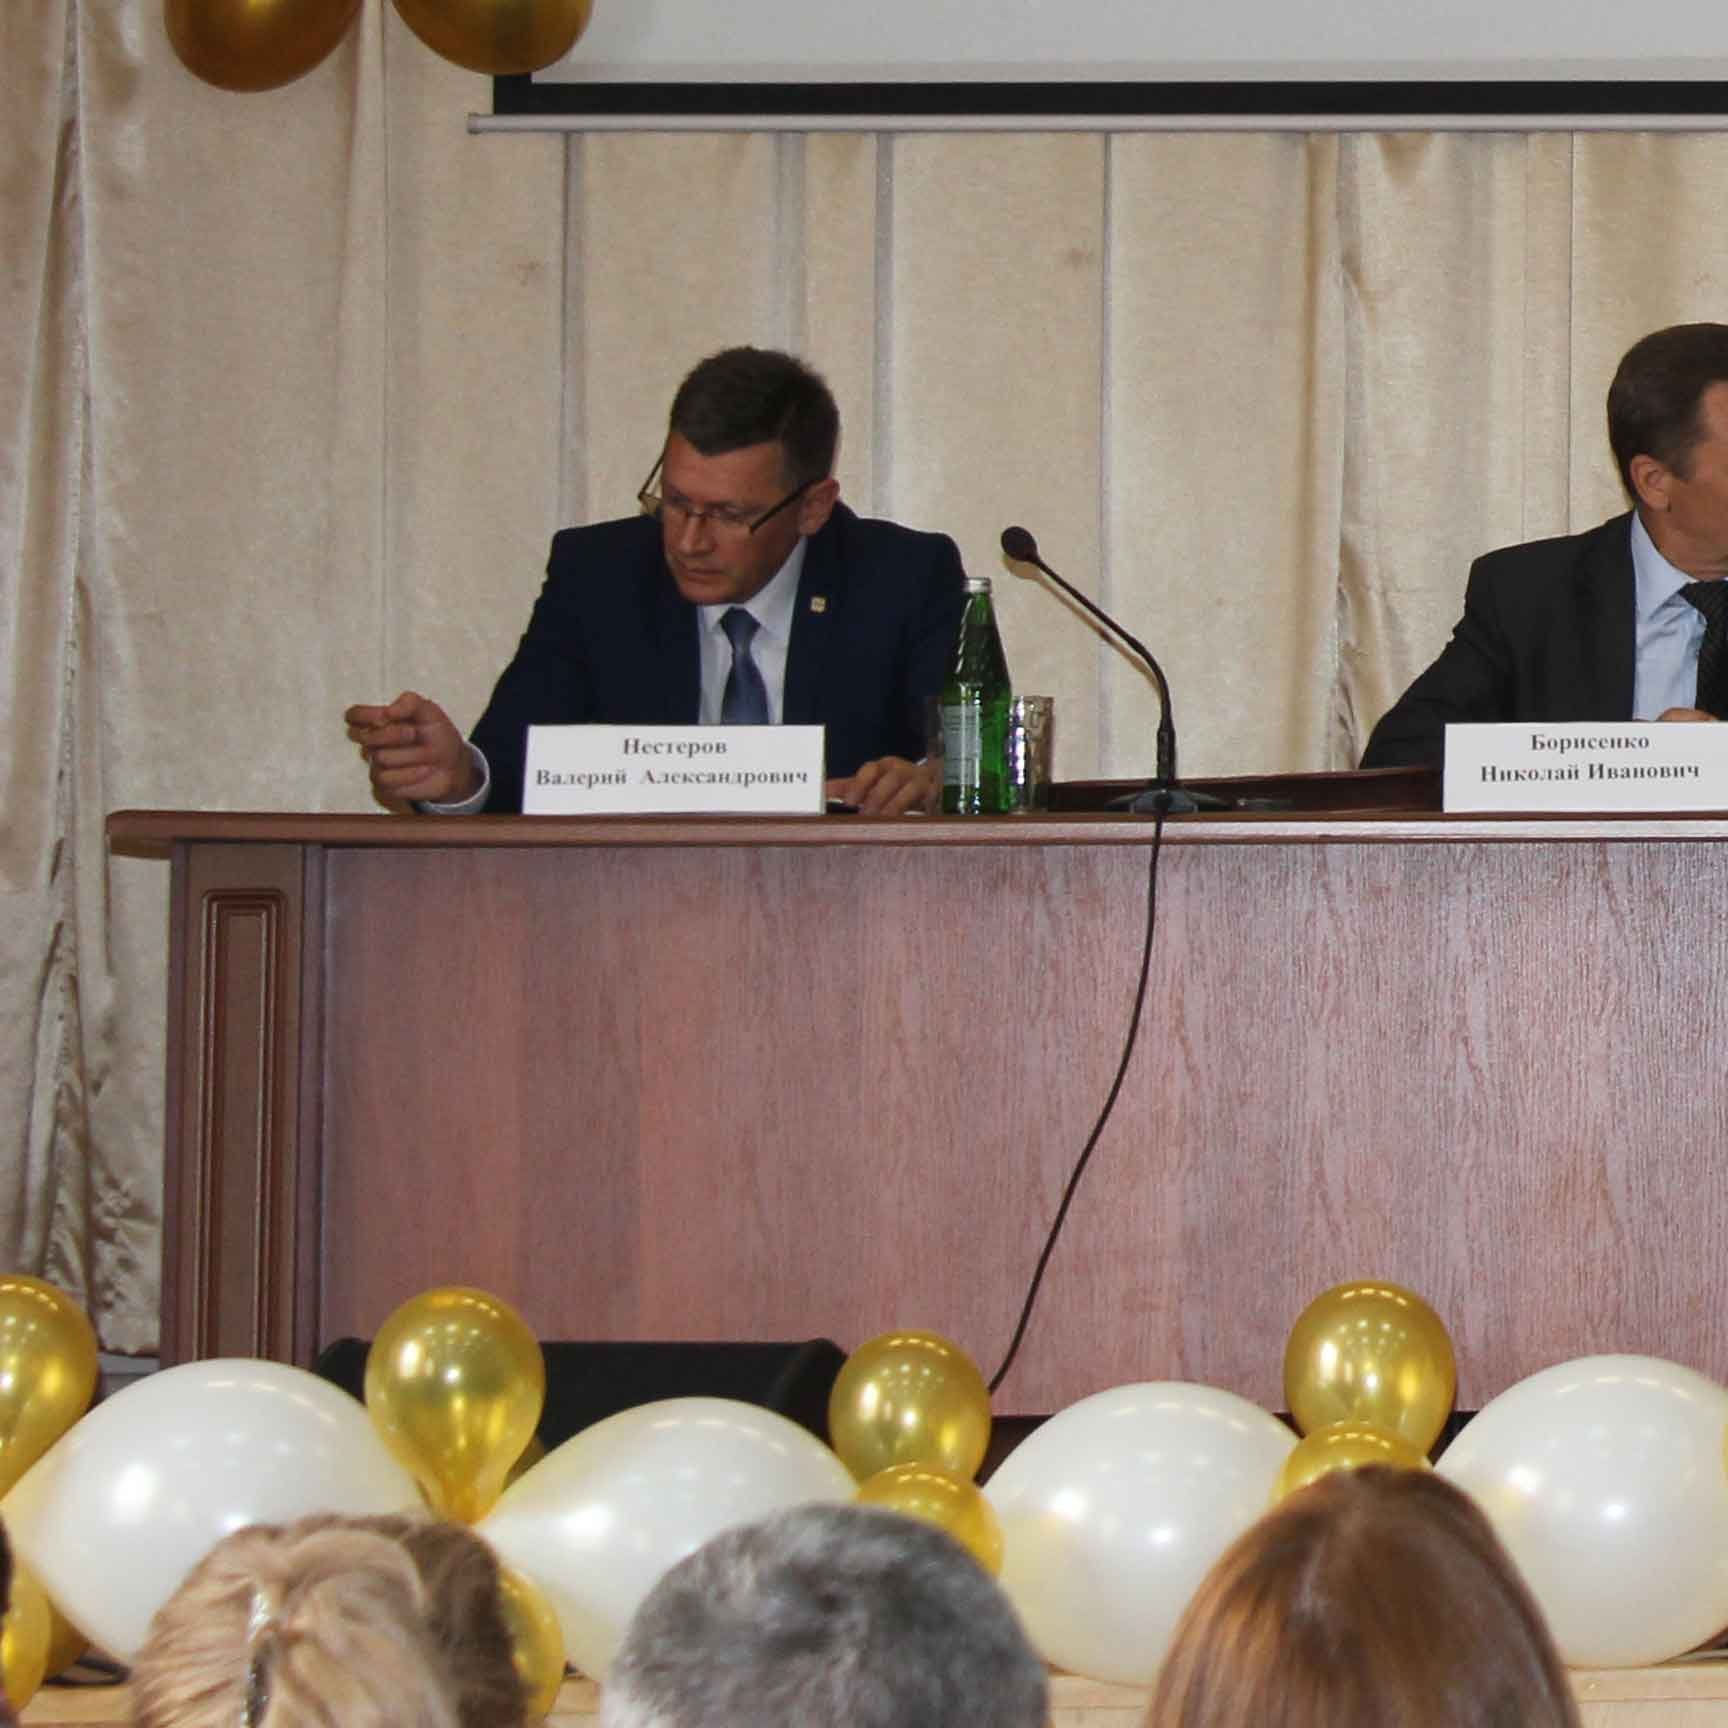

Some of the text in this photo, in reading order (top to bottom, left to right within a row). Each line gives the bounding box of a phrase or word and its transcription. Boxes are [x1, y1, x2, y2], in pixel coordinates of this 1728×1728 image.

[622, 737, 728, 759] Нестеров
[1530, 733, 1650, 755] Борисенко
[535, 768, 808, 789] Валерий Александрович
[1480, 762, 1701, 783] Николай Иванович
